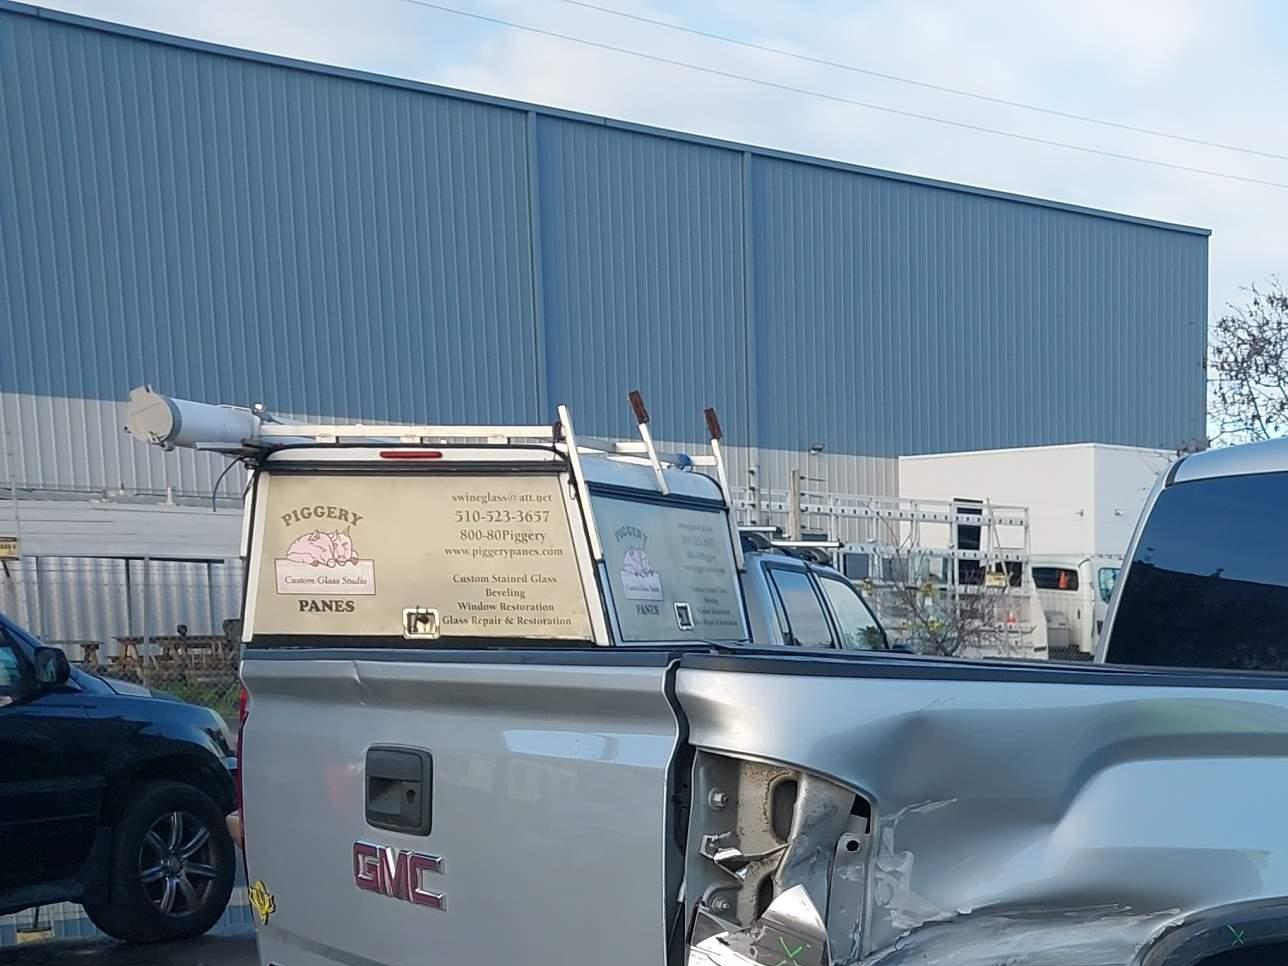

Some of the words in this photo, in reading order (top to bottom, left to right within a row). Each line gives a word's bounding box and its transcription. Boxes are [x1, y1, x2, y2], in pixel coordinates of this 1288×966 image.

[281, 506, 363, 527] PIGGERY
[455, 510, 550, 523] 510-523-3657
[460, 529, 545, 545] 800-80Piggery
[444, 546, 563, 559] www.piggerypanes.com
[284, 576, 315, 585] Custom
[317, 576, 340, 585] Glass
[342, 576, 368, 585] Studio
[452, 574, 489, 583] Custom
[492, 574, 528, 583] Stained
[530, 574, 558, 583] Glass
[485, 588, 526, 598] Beveling
[298, 600, 355, 612] PANES
[457, 602, 497, 611] Window
[500, 602, 554, 611] Restoration
[442, 616, 468, 625] Glass
[471, 616, 502, 627] Repair
[504, 616, 515, 625] &
[517, 616, 572, 625] Restoration
[353, 840, 447, 912] GMC
